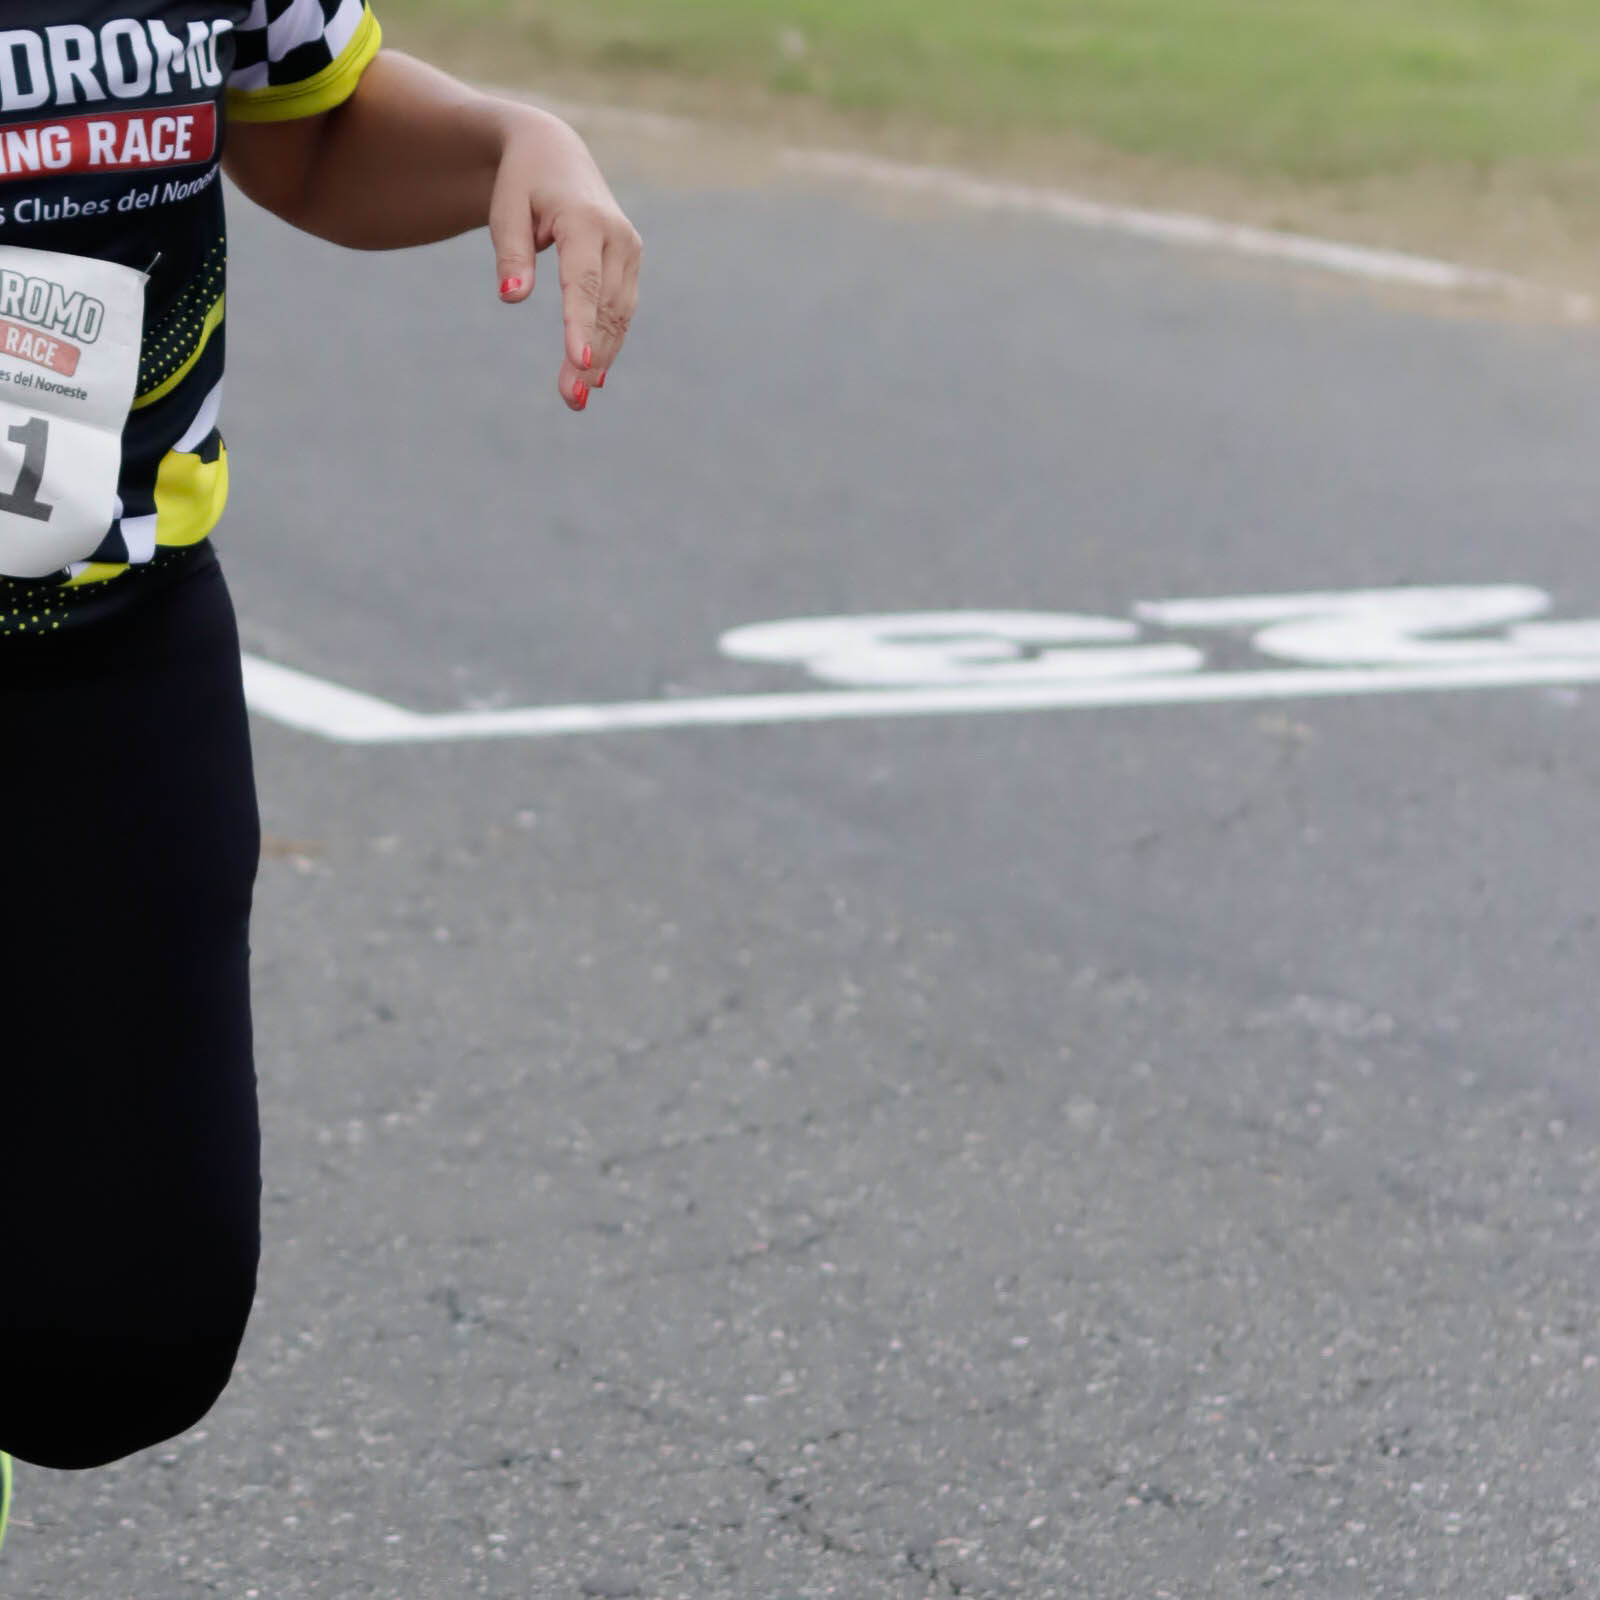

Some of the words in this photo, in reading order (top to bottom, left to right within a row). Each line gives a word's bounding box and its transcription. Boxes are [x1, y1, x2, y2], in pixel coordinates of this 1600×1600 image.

[87, 116, 192, 165] RACE
[14, 196, 110, 224] Clubes
[117, 184, 159, 212] del
[4, 331, 60, 369] RACE
[13, 373, 33, 388] del
[34, 376, 89, 401] Noroeste
